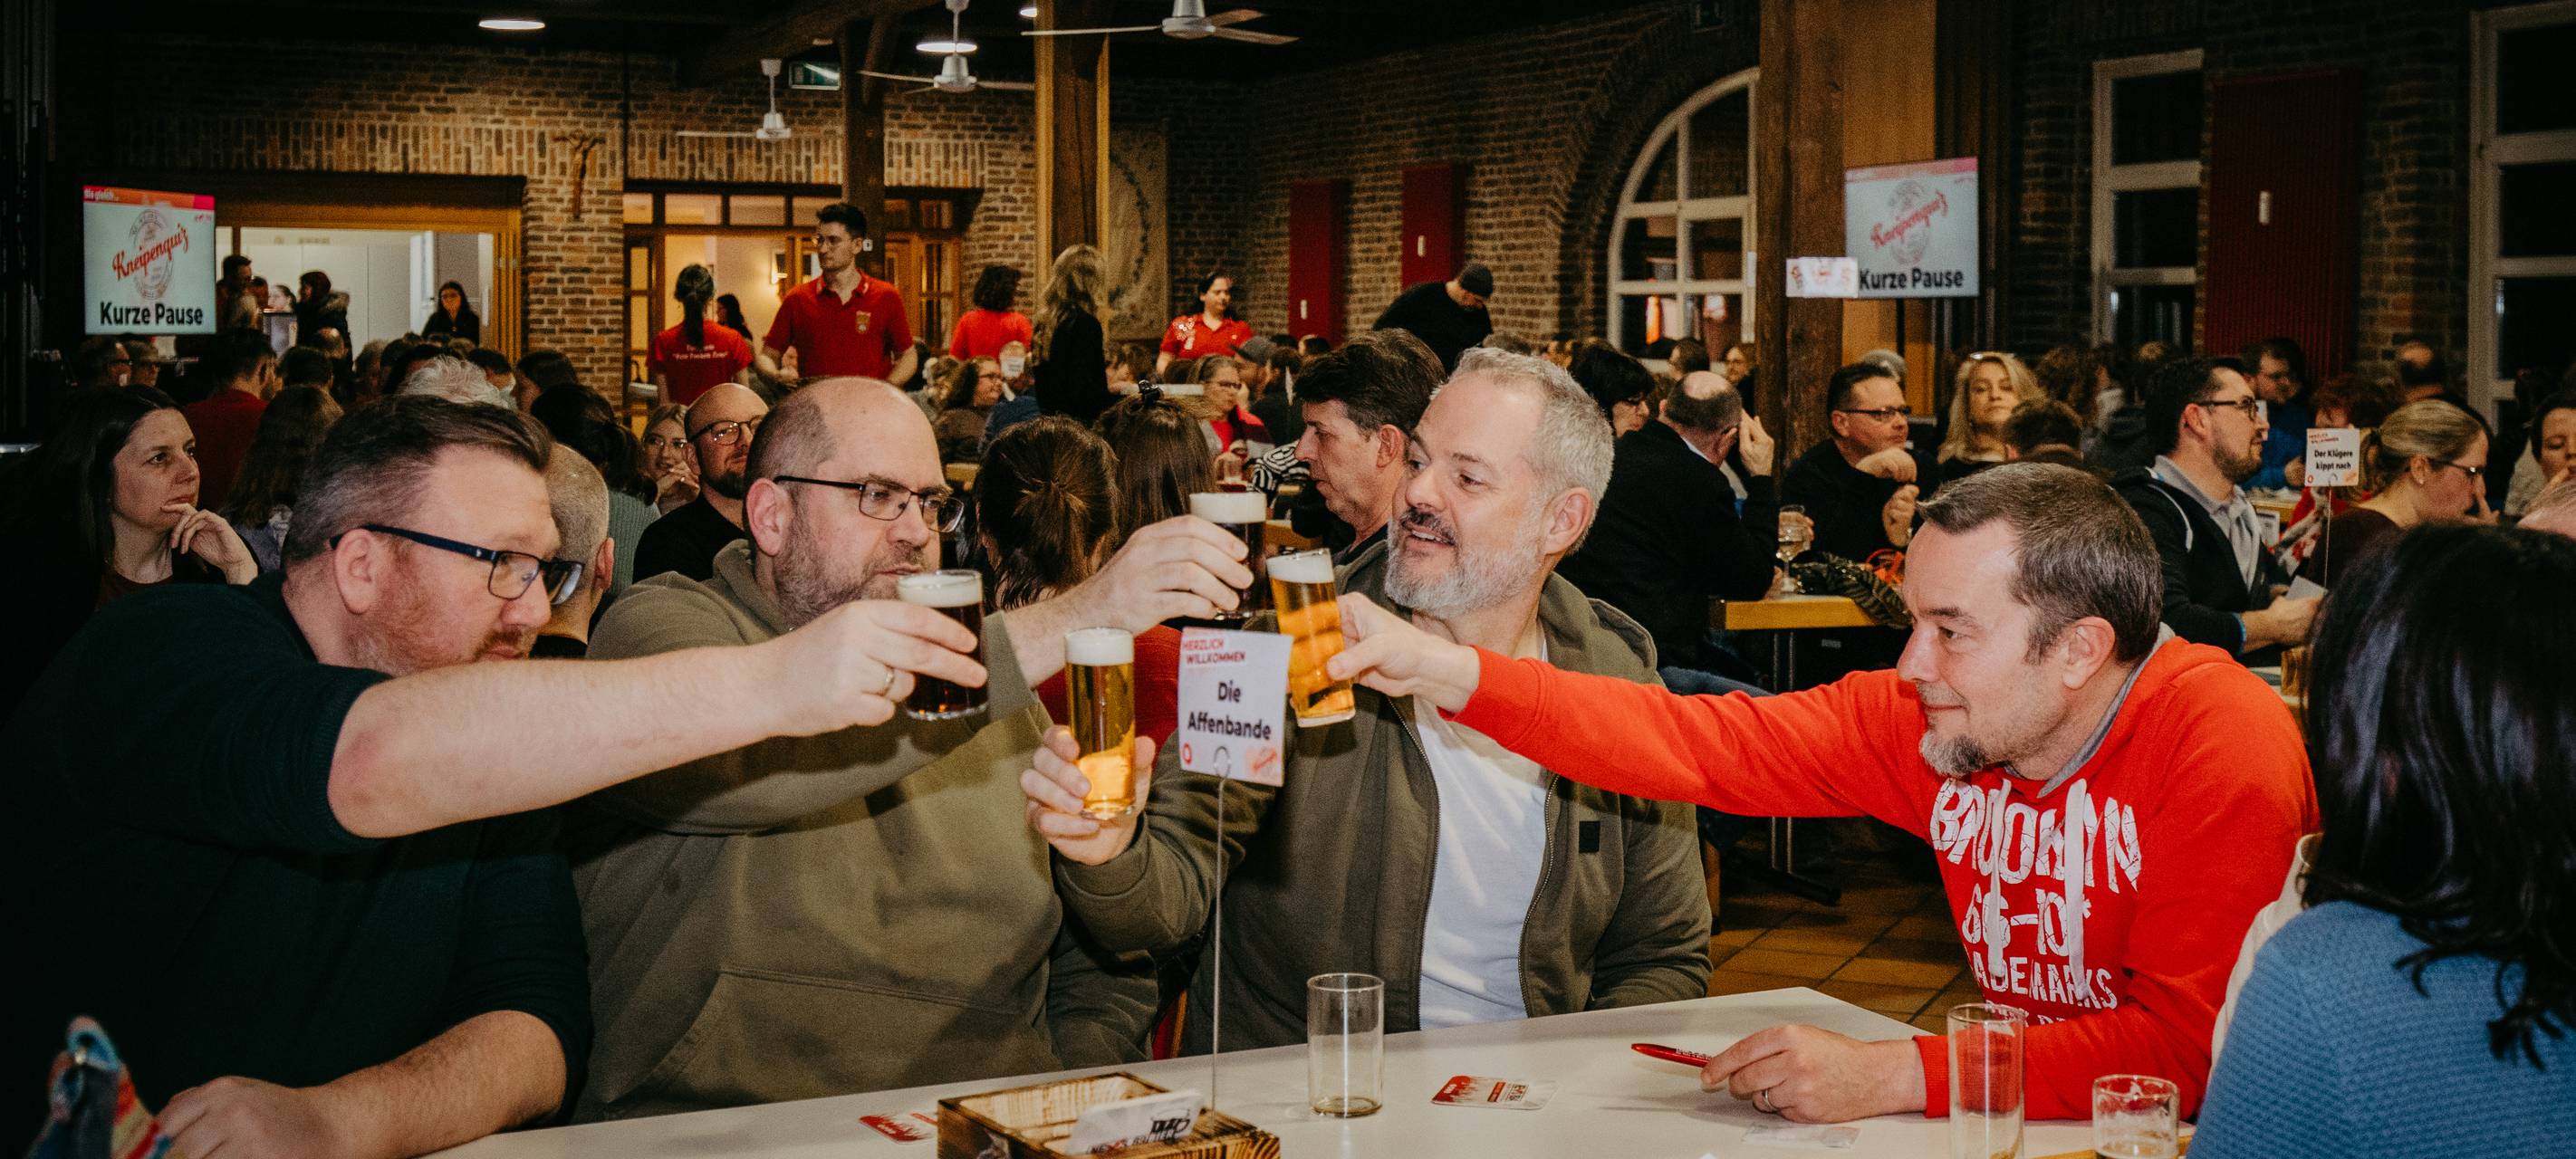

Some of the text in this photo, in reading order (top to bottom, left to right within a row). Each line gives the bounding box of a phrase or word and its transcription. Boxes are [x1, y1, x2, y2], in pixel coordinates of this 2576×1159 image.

[111, 222, 189, 282] Kneipenquiz
[1860, 267, 1965, 290] Kurze Pause
[100, 301, 204, 326] Kurze Pause
[2314, 449, 2326, 457] Der
[2316, 462, 2334, 471] kippt
[1182, 638, 1225, 651] HERZLICH
[1187, 651, 1246, 665] WILLKOMMEN
[1218, 680, 1241, 703] Die
[1187, 711, 1272, 740] Affenbande
